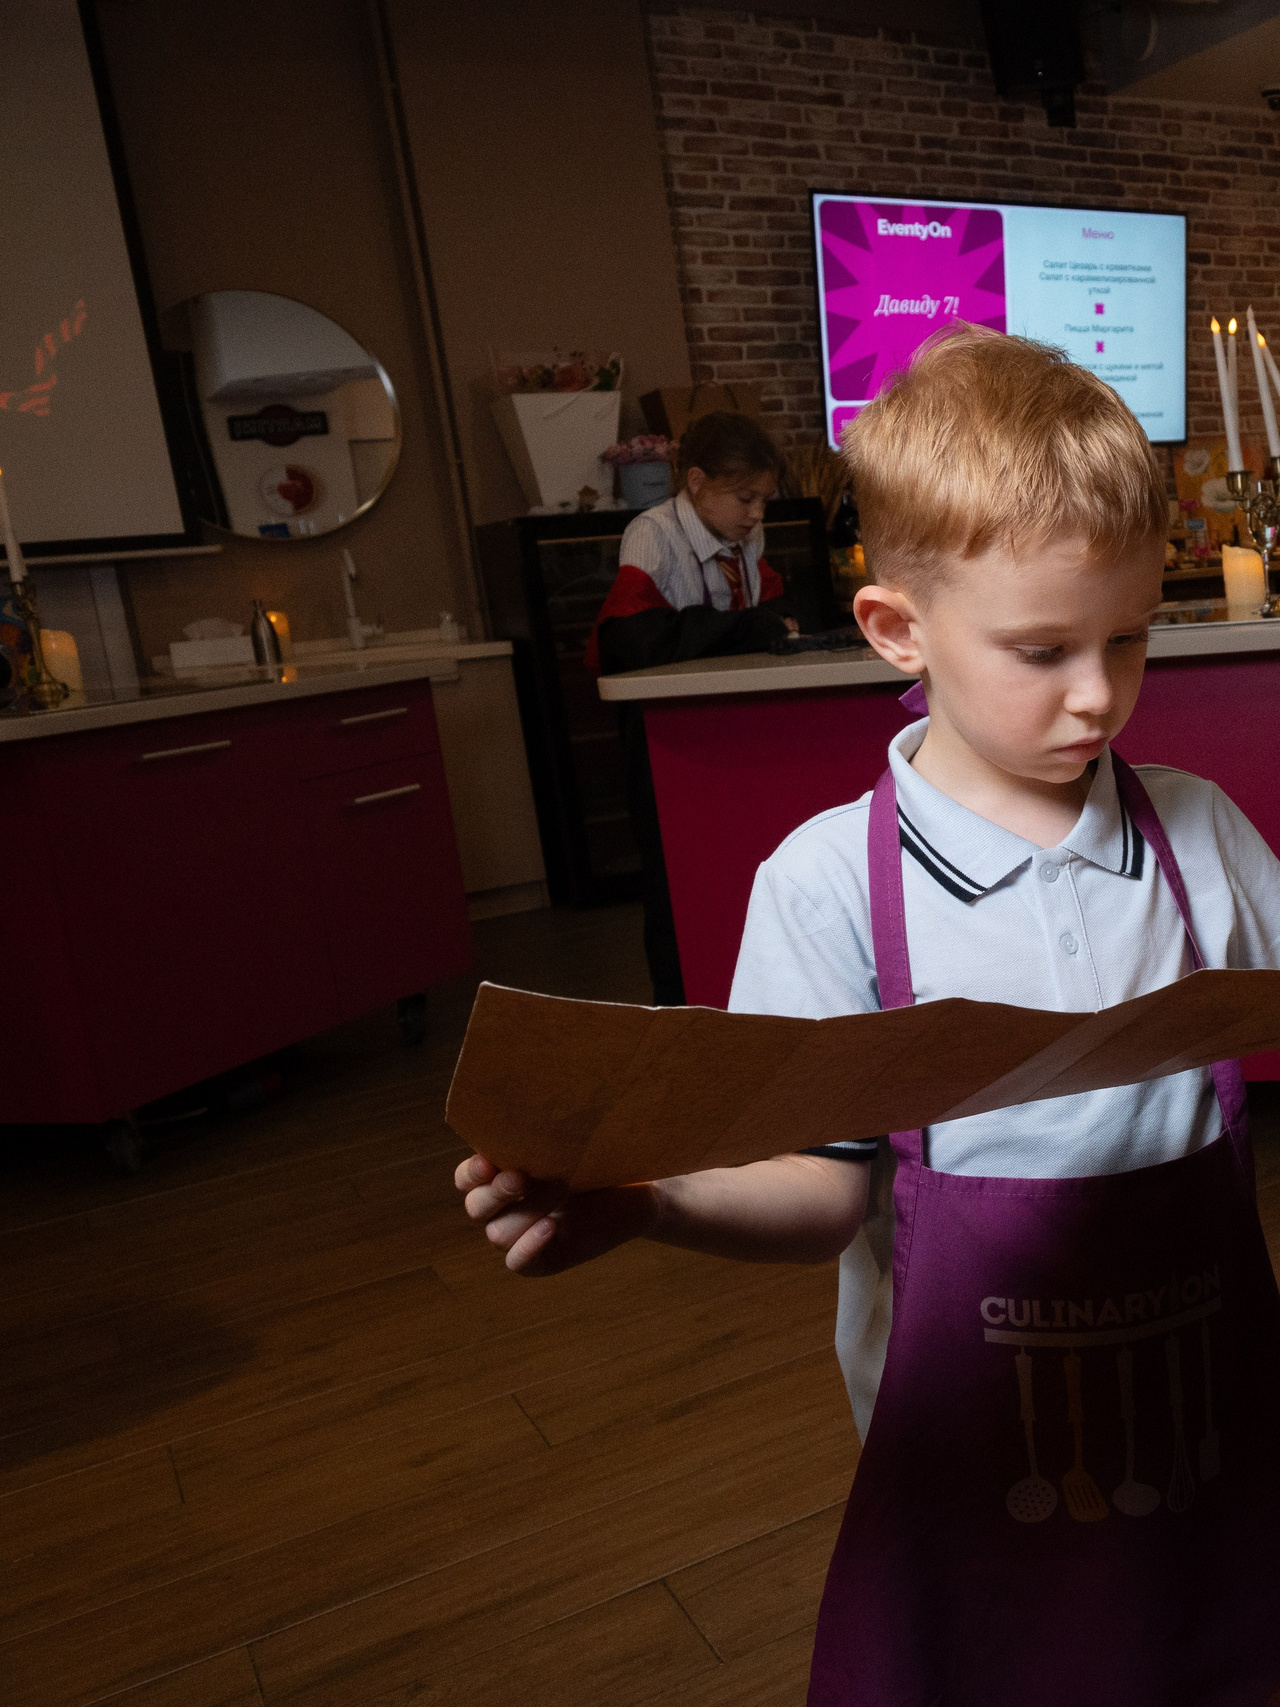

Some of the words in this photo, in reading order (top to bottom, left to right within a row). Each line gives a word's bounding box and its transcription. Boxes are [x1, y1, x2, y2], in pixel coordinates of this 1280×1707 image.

[877, 218, 952, 241] EventyOn
[1082, 227, 1114, 239] Меню
[1043, 259, 1067, 269] Салат
[1039, 271, 1063, 281] Салат
[874, 294, 940, 319] Давиду
[943, 296, 960, 315] 7!
[1092, 323, 1134, 334] Маргарита
